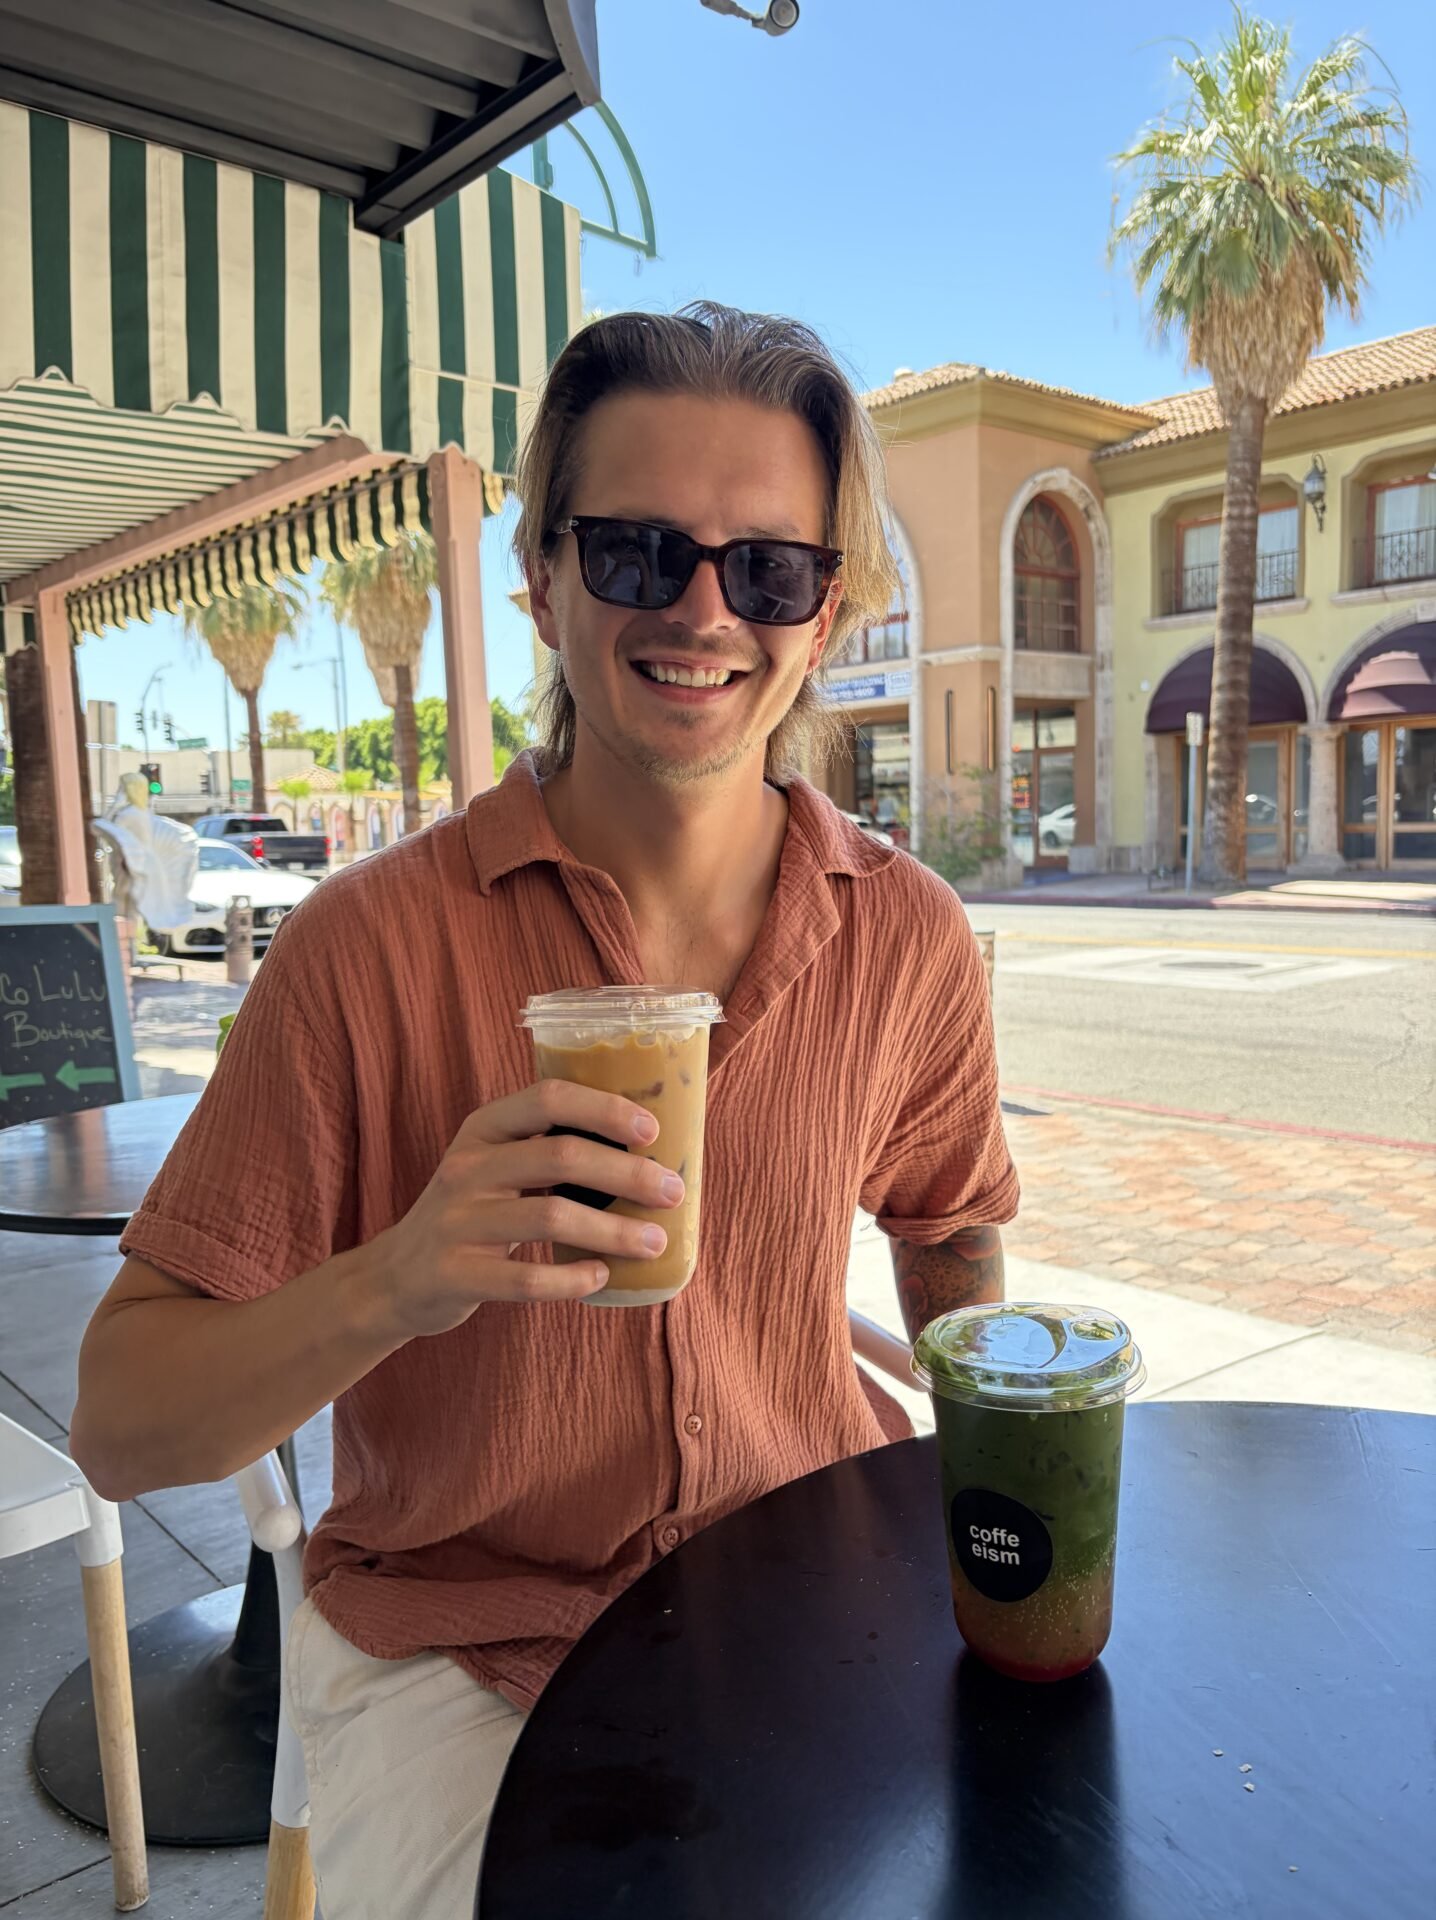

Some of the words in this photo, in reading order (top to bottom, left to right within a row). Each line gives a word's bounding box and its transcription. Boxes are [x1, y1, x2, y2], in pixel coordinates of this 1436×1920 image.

[4, 1010, 113, 1049] Boutique
[969, 1525, 1020, 1547] coffe
[971, 1542, 1020, 1566] eism
